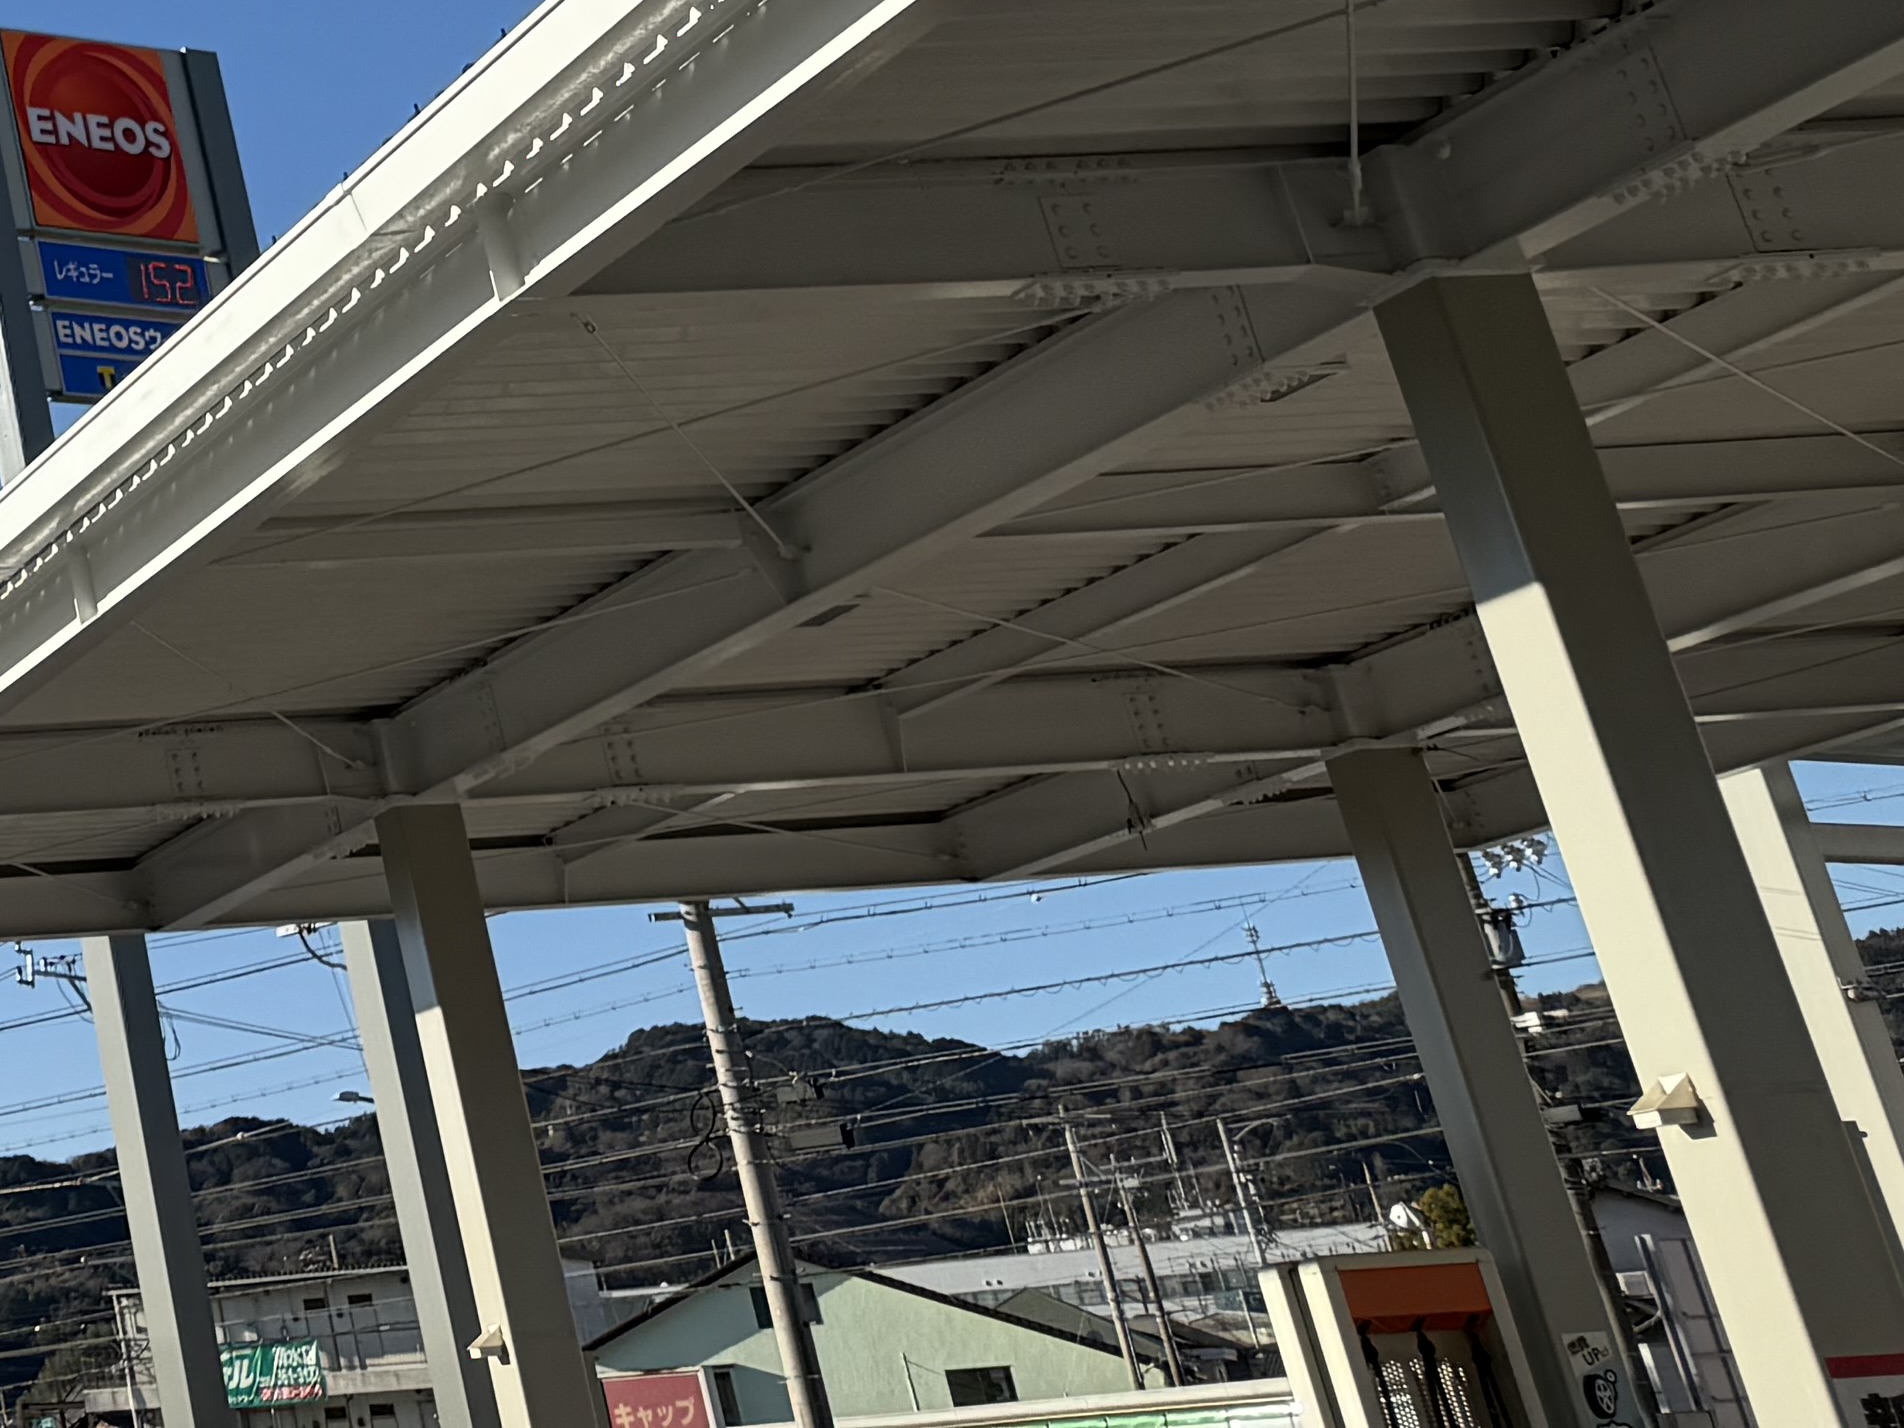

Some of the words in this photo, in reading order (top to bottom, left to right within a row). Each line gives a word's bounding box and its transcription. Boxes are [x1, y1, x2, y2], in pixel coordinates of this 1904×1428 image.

[26, 106, 171, 159] ENEOS
[54, 259, 114, 284] レギュラー
[141, 261, 199, 305] 152
[55, 319, 166, 351] ENEOSウ
